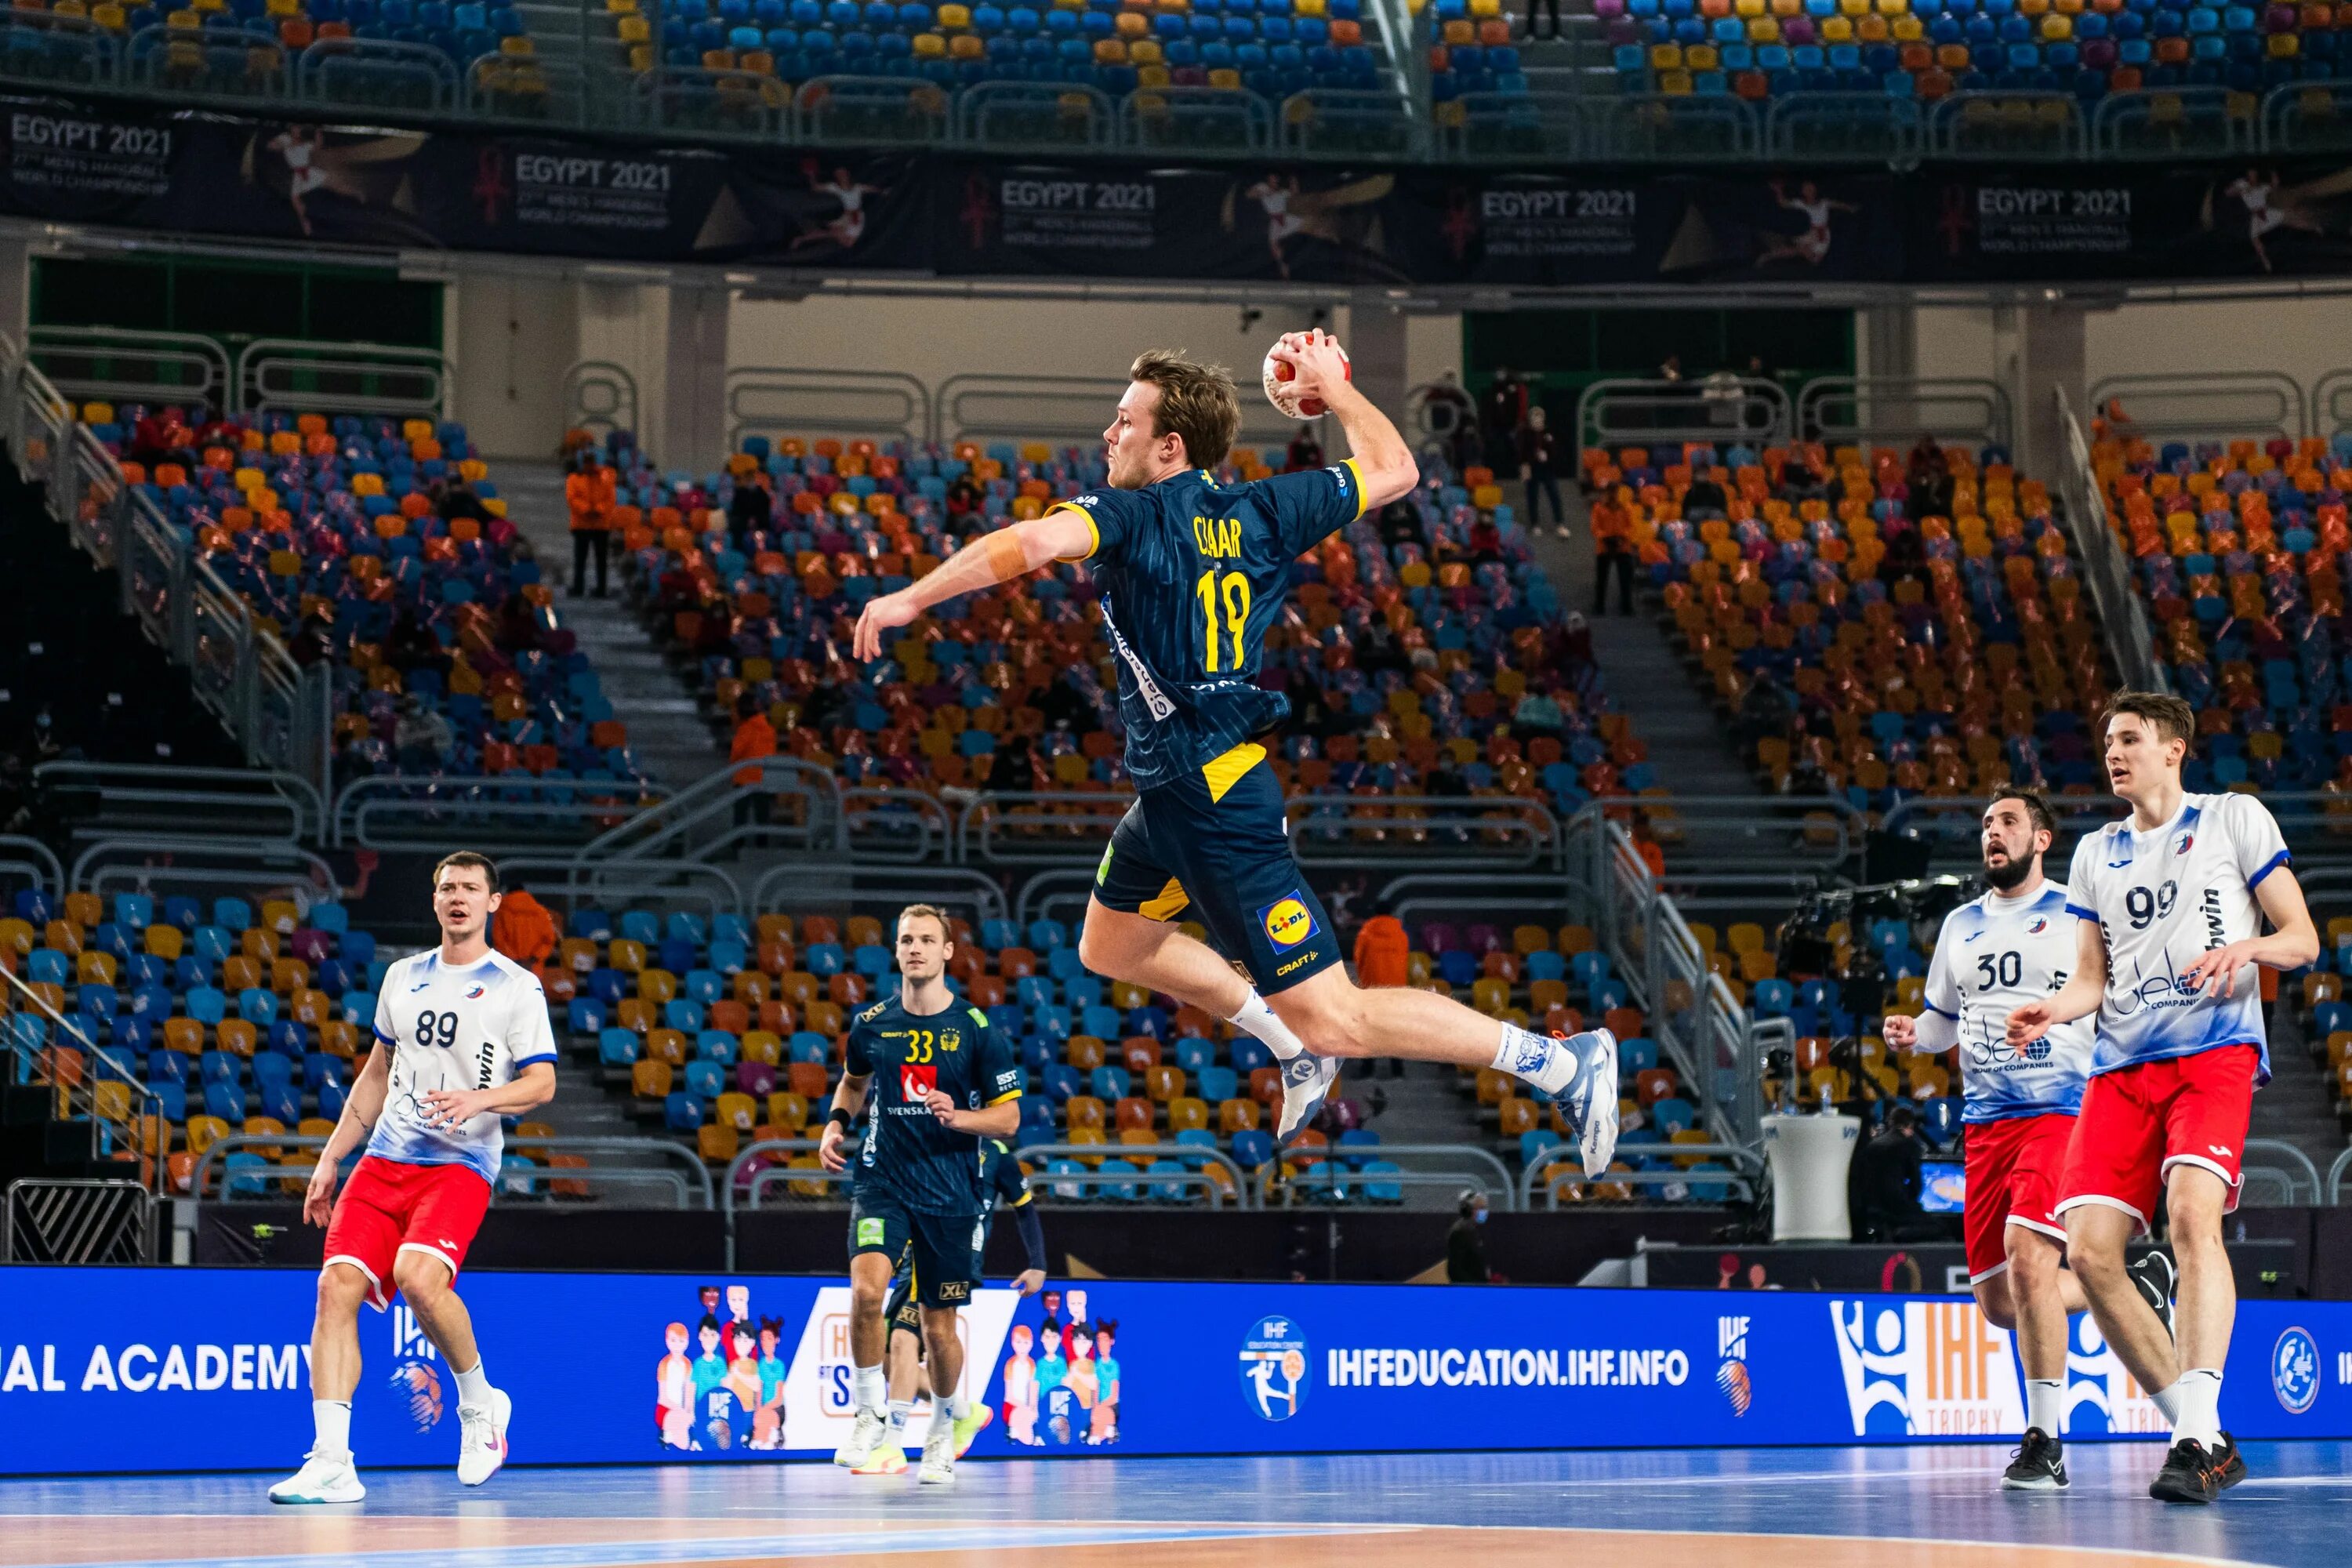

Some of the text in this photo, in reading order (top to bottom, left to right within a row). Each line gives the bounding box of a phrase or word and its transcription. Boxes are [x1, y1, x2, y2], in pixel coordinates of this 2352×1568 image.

[12, 113, 171, 156] EGYPT 2021
[516, 154, 670, 191] EGYPT 2021
[1002, 180, 1156, 209] EGYPT 2021
[1482, 191, 1636, 217] EGYPT 2021
[1978, 187, 2132, 216] EGYPT 2021
[1196, 570, 1250, 673] 19
[2125, 879, 2178, 930] 99
[1276, 954, 1308, 977] CRAFT
[1977, 950, 2022, 991] 30
[416, 1010, 459, 1048] 89
[906, 1029, 934, 1063] 33
[2004, 1062, 2054, 1071] COMPANIES
[887, 1106, 933, 1116] SVENSKA
[1590, 1120, 1601, 1154] Kempa
[1263, 1322, 1288, 1339] IHF
[1328, 1348, 1689, 1386] IHFEDUCATION.IHF.INFO
[1926, 1302, 2001, 1400] IHF
[1927, 1409, 2002, 1436] TROPHY
